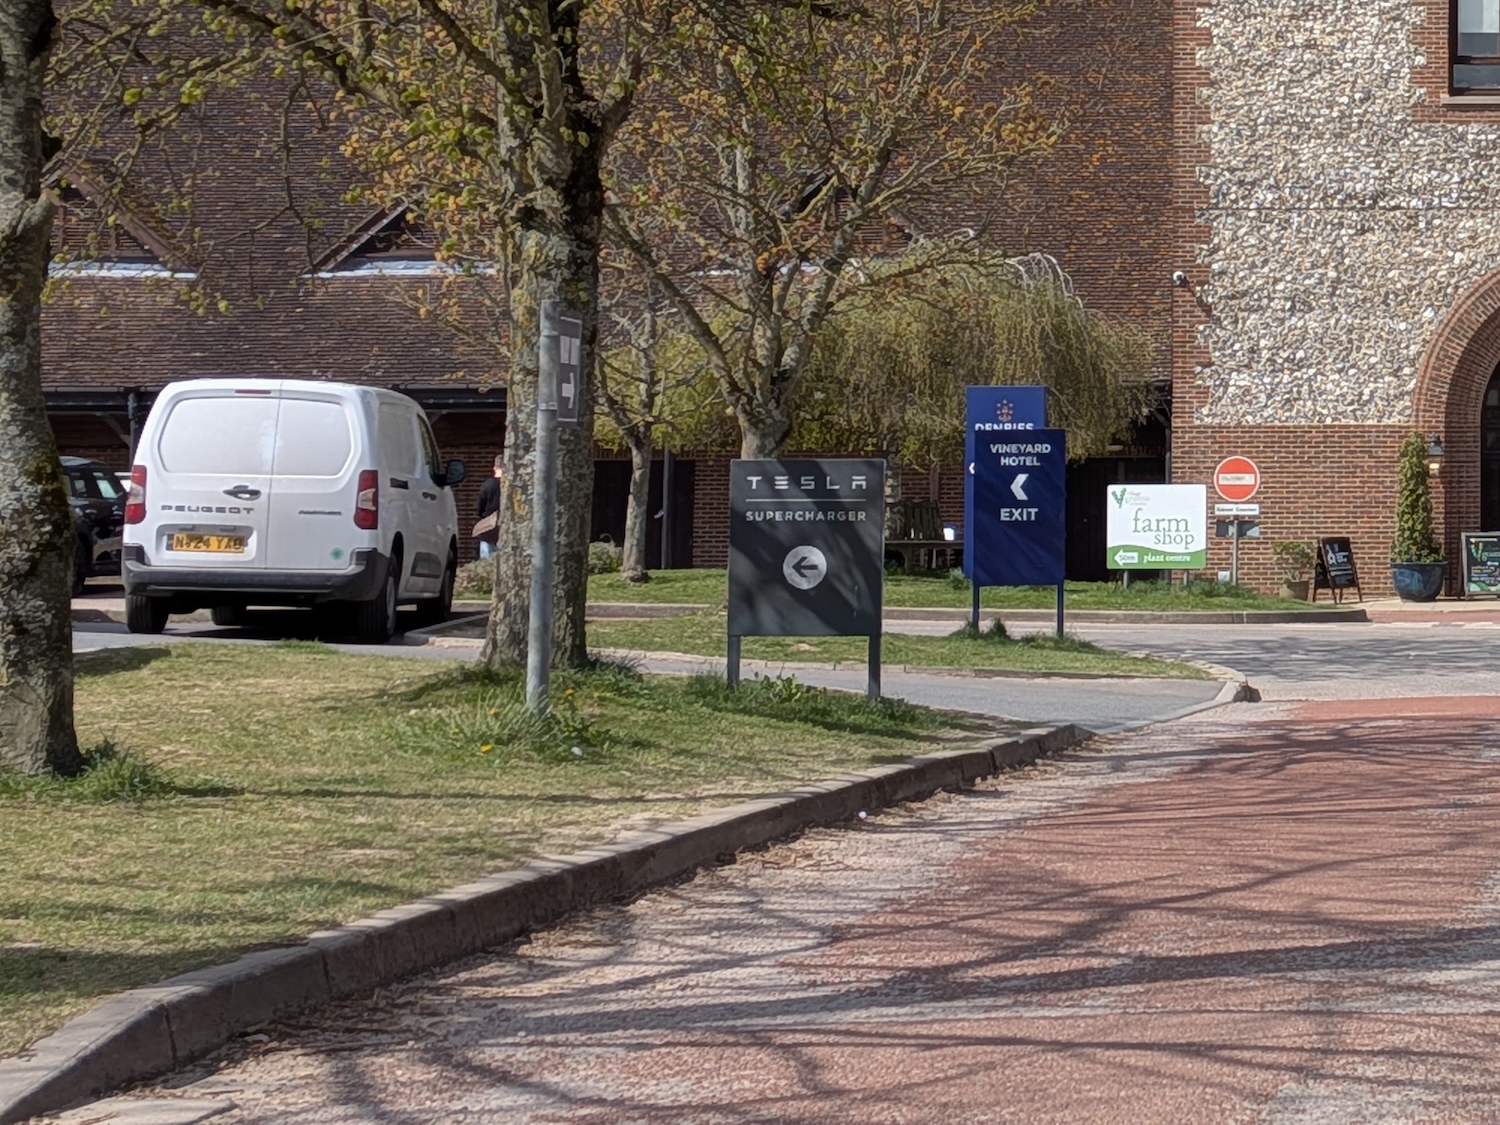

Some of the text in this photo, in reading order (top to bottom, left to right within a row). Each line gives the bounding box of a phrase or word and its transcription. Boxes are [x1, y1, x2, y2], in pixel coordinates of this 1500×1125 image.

[990, 443, 1052, 454] VINEYARD
[1000, 456, 1041, 466] HOTEL
[746, 475, 867, 490] TESLA
[161, 504, 255, 514] PEUGEOT
[1000, 508, 1039, 522] EXIT
[745, 510, 867, 522] SUPERCHARGER
[1131, 507, 1191, 533] farm
[1153, 527, 1195, 550] shop
